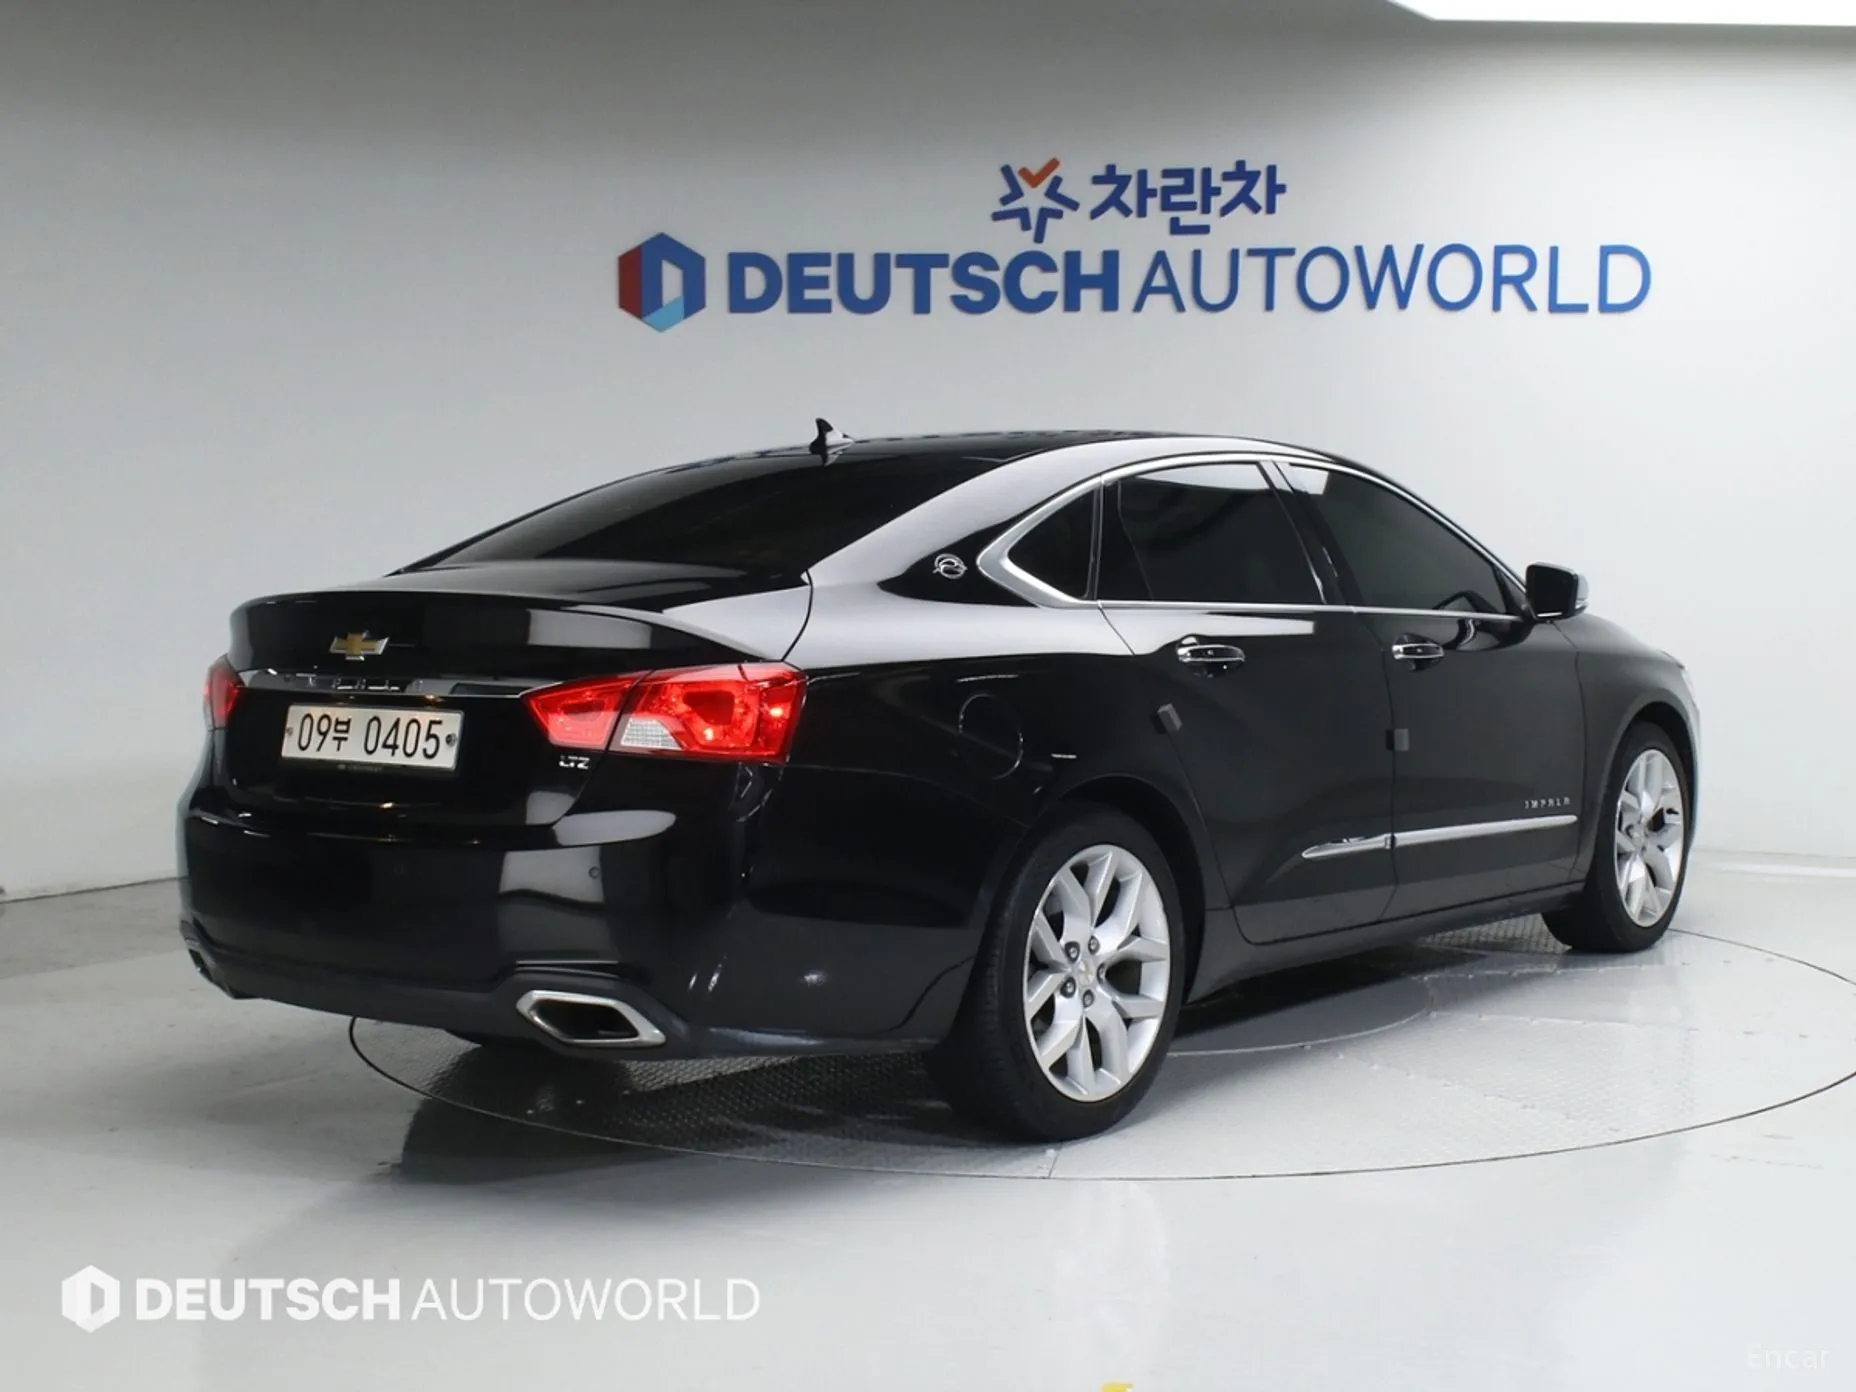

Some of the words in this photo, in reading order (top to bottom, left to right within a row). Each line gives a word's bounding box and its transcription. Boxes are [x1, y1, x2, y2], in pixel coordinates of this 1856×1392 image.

[1090, 160, 1287, 235] 차란차
[727, 250, 1120, 315] DEUTSCH
[1133, 243, 1652, 314] AUTOWORLD
[297, 713, 351, 752] 09부
[363, 715, 443, 760] 0405
[1524, 796, 1571, 809] IMPALA
